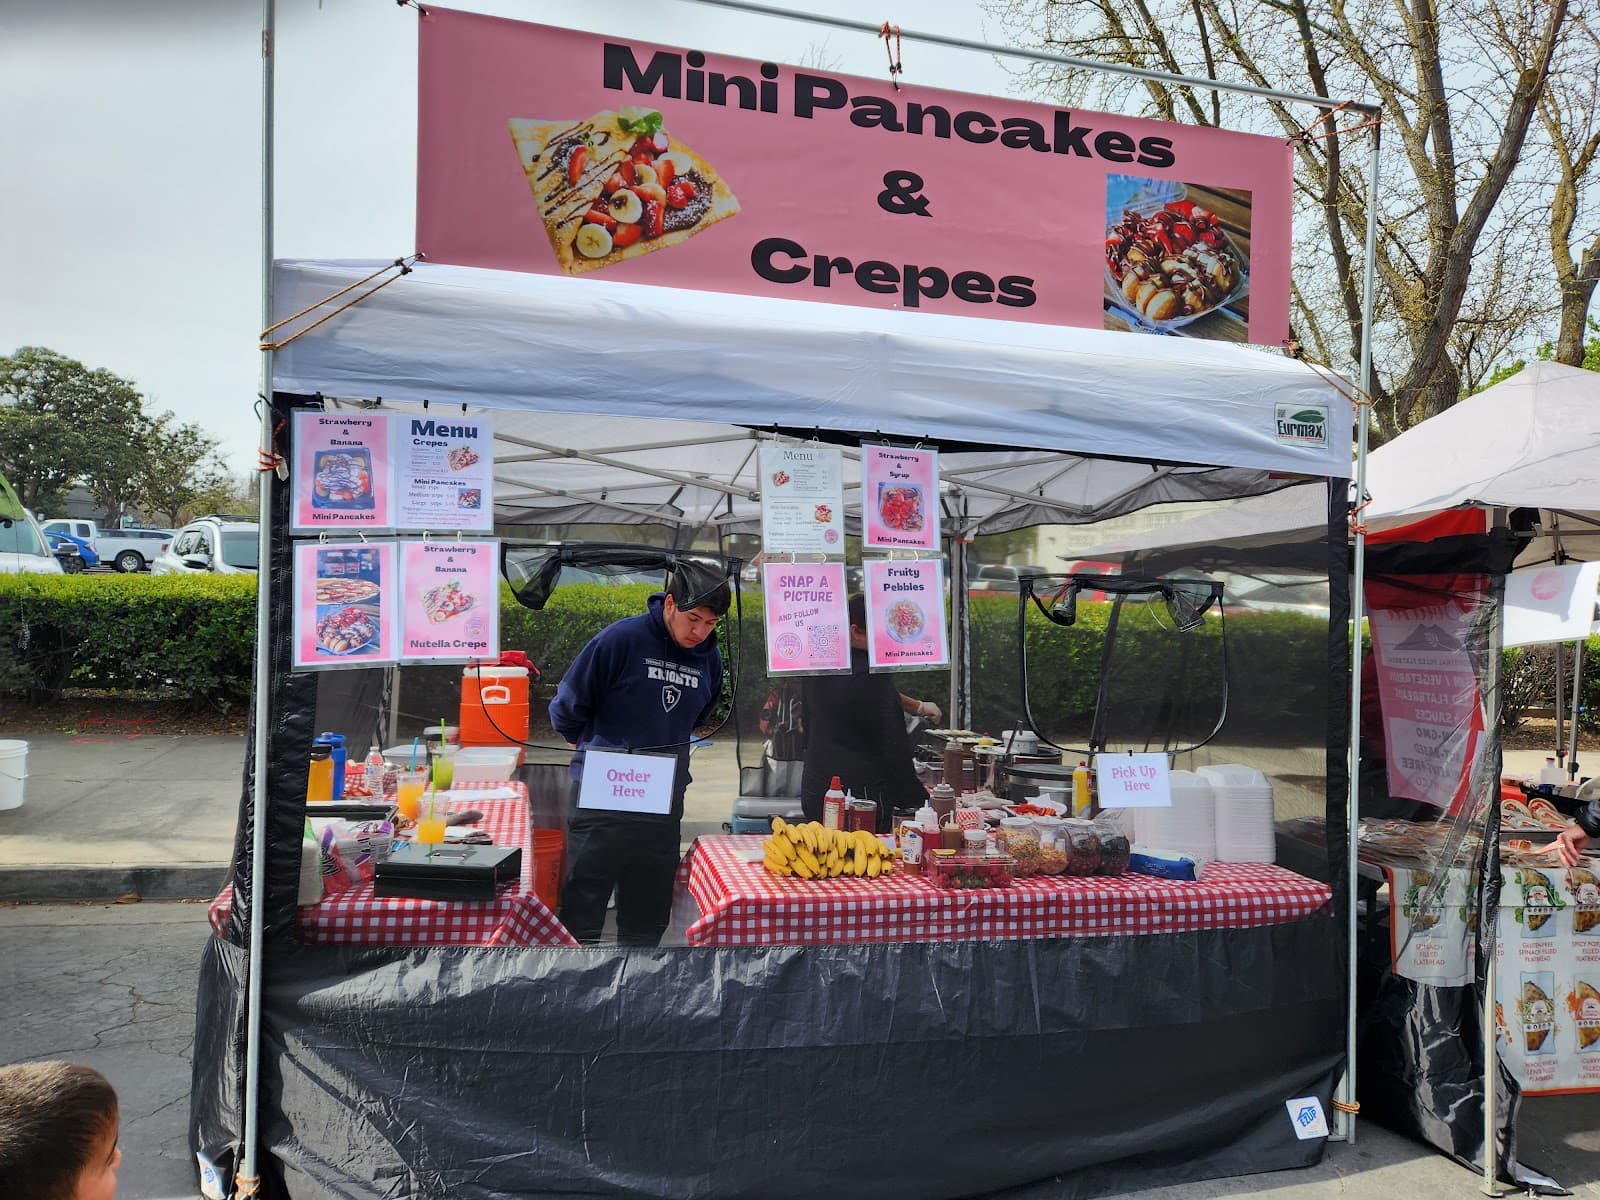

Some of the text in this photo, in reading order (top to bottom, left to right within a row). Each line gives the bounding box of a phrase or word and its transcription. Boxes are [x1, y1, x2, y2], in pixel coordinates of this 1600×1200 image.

[603, 43, 1175, 168] Mini Pancakes
[877, 170, 933, 218] &
[750, 238, 1036, 308] Crepes
[319, 418, 372, 427] Strawberry
[411, 419, 478, 439] Menu
[1277, 420, 1323, 438] Eurmax
[413, 438, 448, 447] Crepes
[783, 451, 813, 461] Menu
[878, 452, 919, 462] Strawberry
[889, 471, 910, 479] Syrup
[893, 537, 925, 545] Pancakes
[424, 546, 476, 554] Strawberry
[887, 568, 920, 578] Fruity
[780, 575, 828, 587] SNAP A
[883, 583, 925, 592] Pebbles
[783, 590, 833, 602] PICTURE
[778, 608, 819, 623] AND FOLLOW
[410, 640, 487, 649] Nutella Crepe
[648, 666, 698, 688] KNIGHTS
[607, 769, 651, 783] Order
[1112, 766, 1156, 778] Pick Up
[613, 785, 645, 797] Here
[1124, 781, 1150, 791] Here
